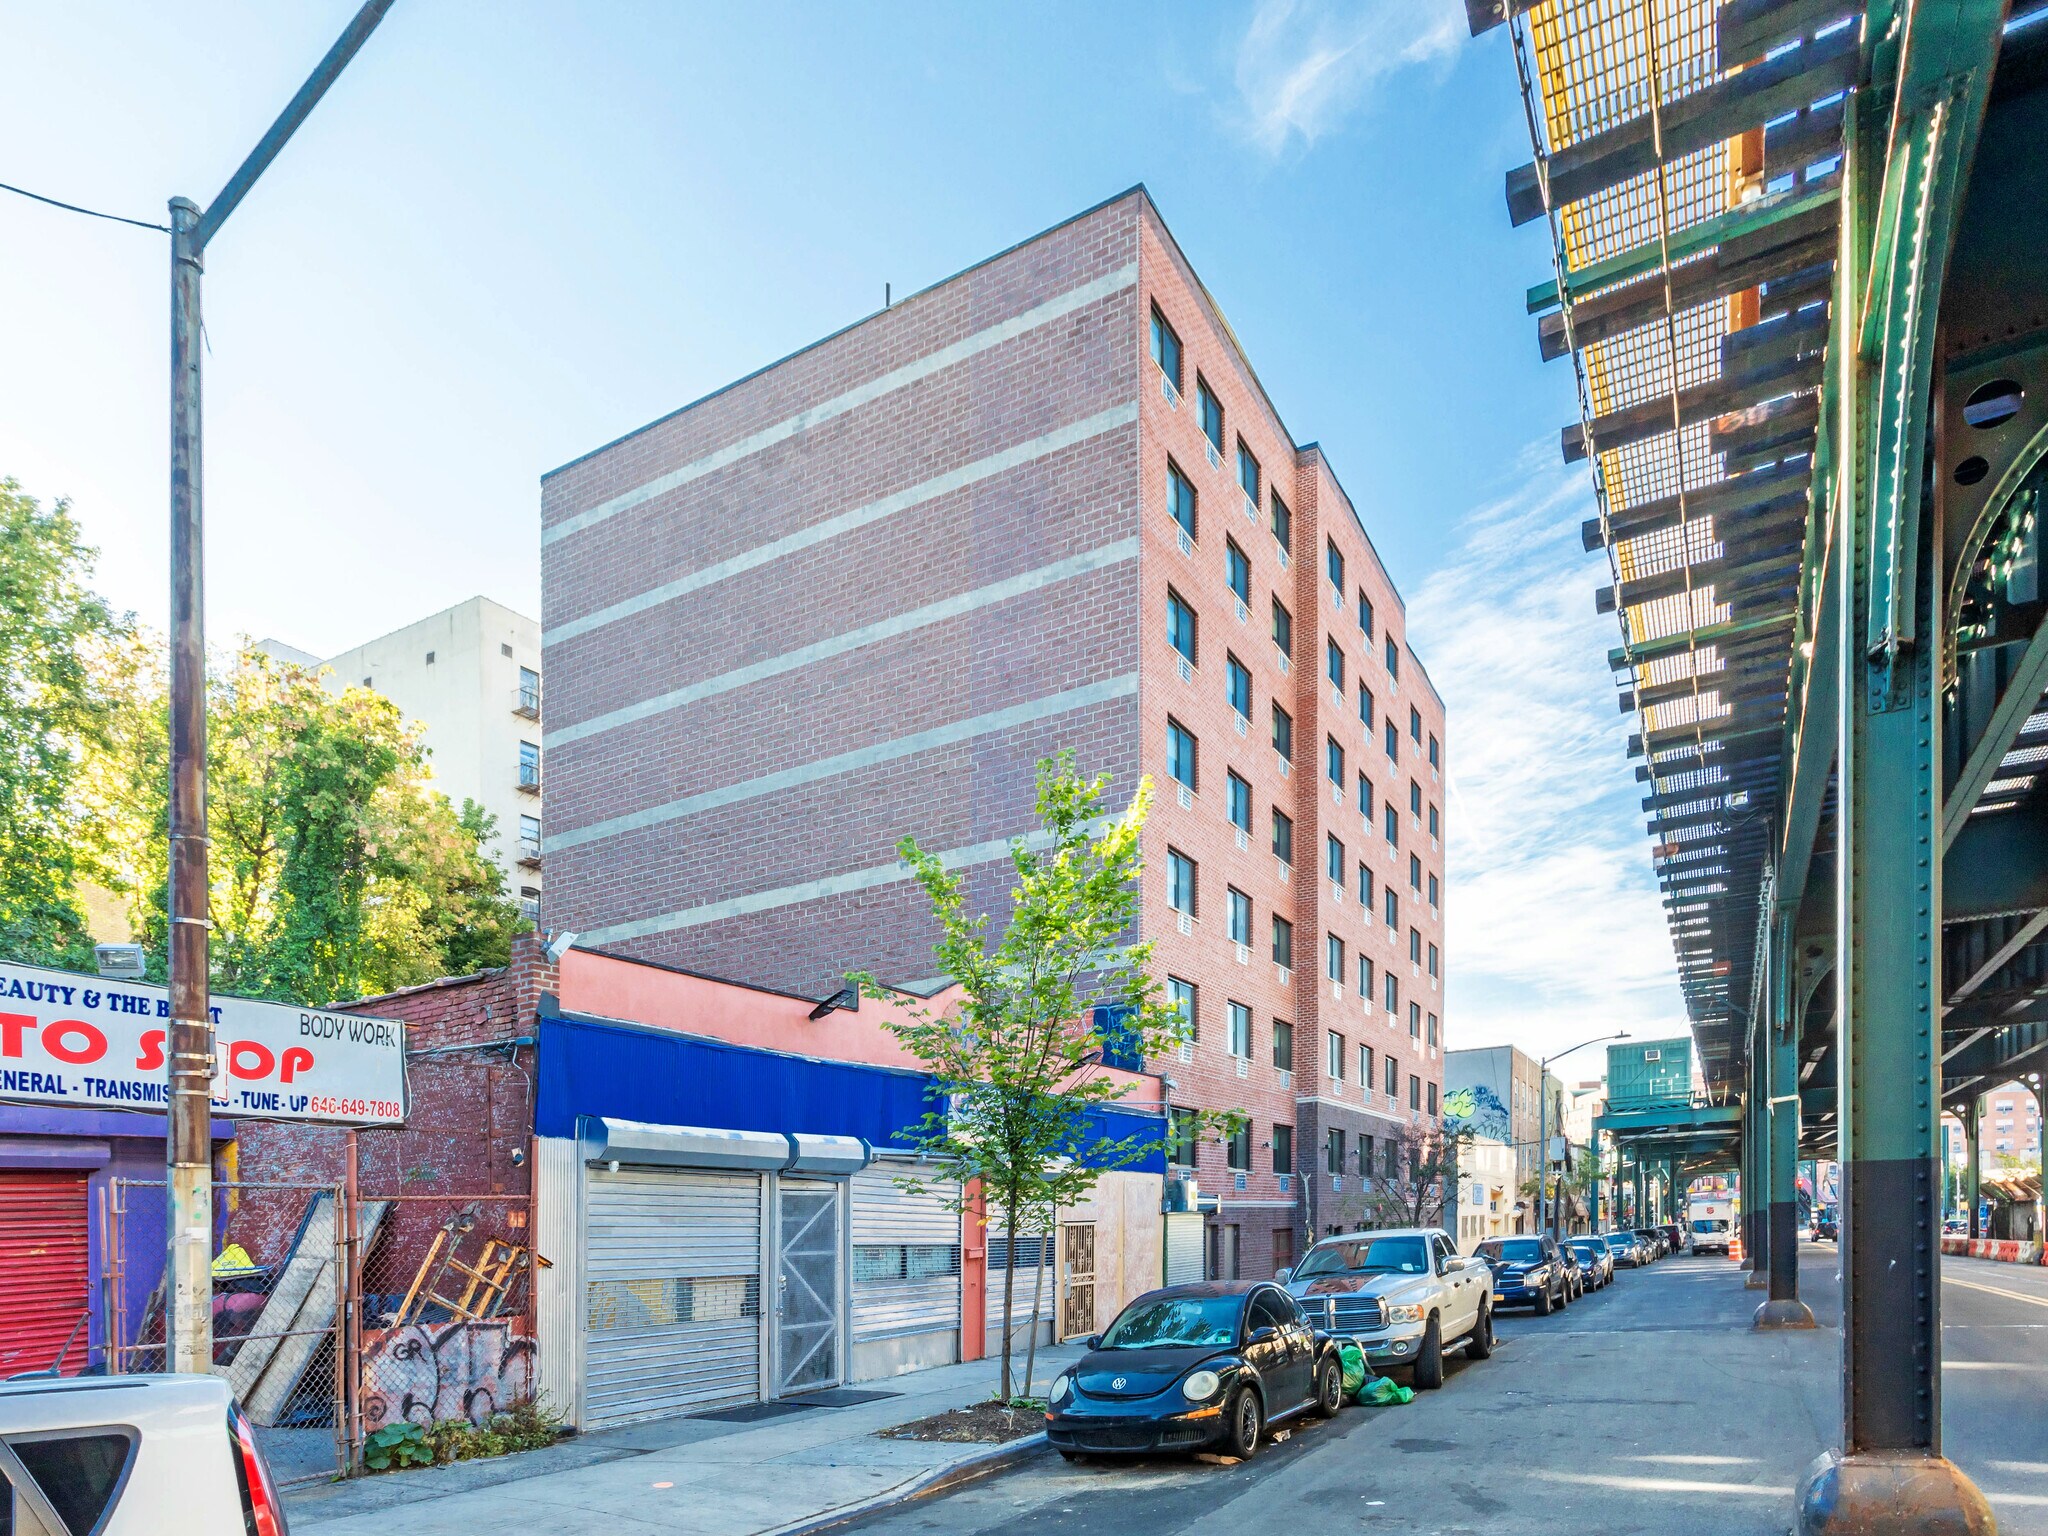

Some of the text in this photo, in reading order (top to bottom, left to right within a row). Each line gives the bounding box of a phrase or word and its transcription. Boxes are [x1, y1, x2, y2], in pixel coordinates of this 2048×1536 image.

[82, 989, 101, 1009] &
[107, 993, 151, 1016] THE
[156, 1000, 222, 1024] BT
[300, 1013, 396, 1047] BODY WORK
[135, 1029, 315, 1084] SOP
[0, 1069, 67, 1095] NERAL
[311, 1096, 400, 1118] 646-649-7808
